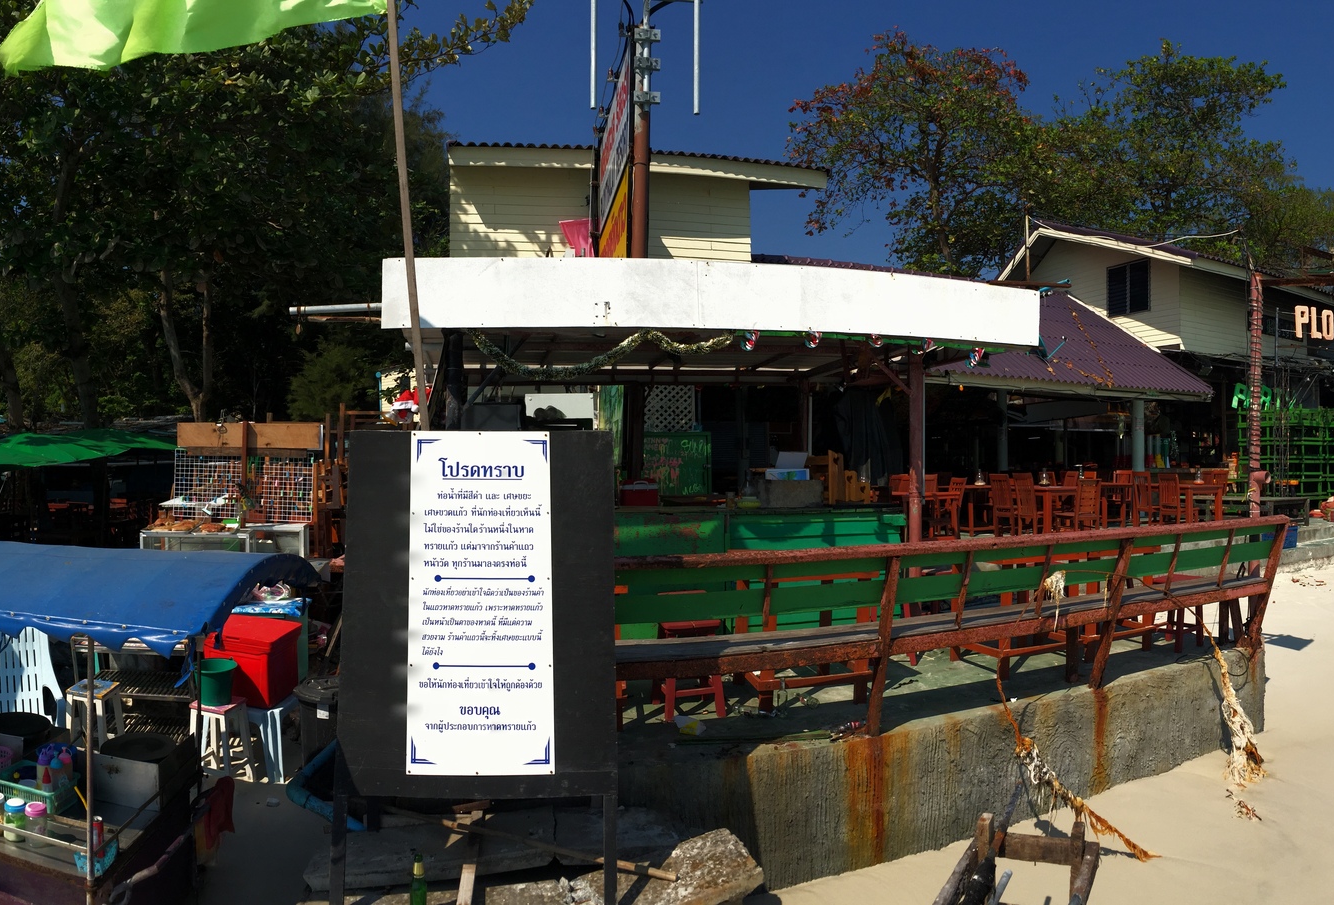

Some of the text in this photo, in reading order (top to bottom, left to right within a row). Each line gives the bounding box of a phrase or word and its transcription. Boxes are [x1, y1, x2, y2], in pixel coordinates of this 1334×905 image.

[438, 458, 524, 477] โปรดทราบ
[424, 541, 457, 550] ทรายแก้ว
[459, 706, 500, 719] ขอบคุณ
